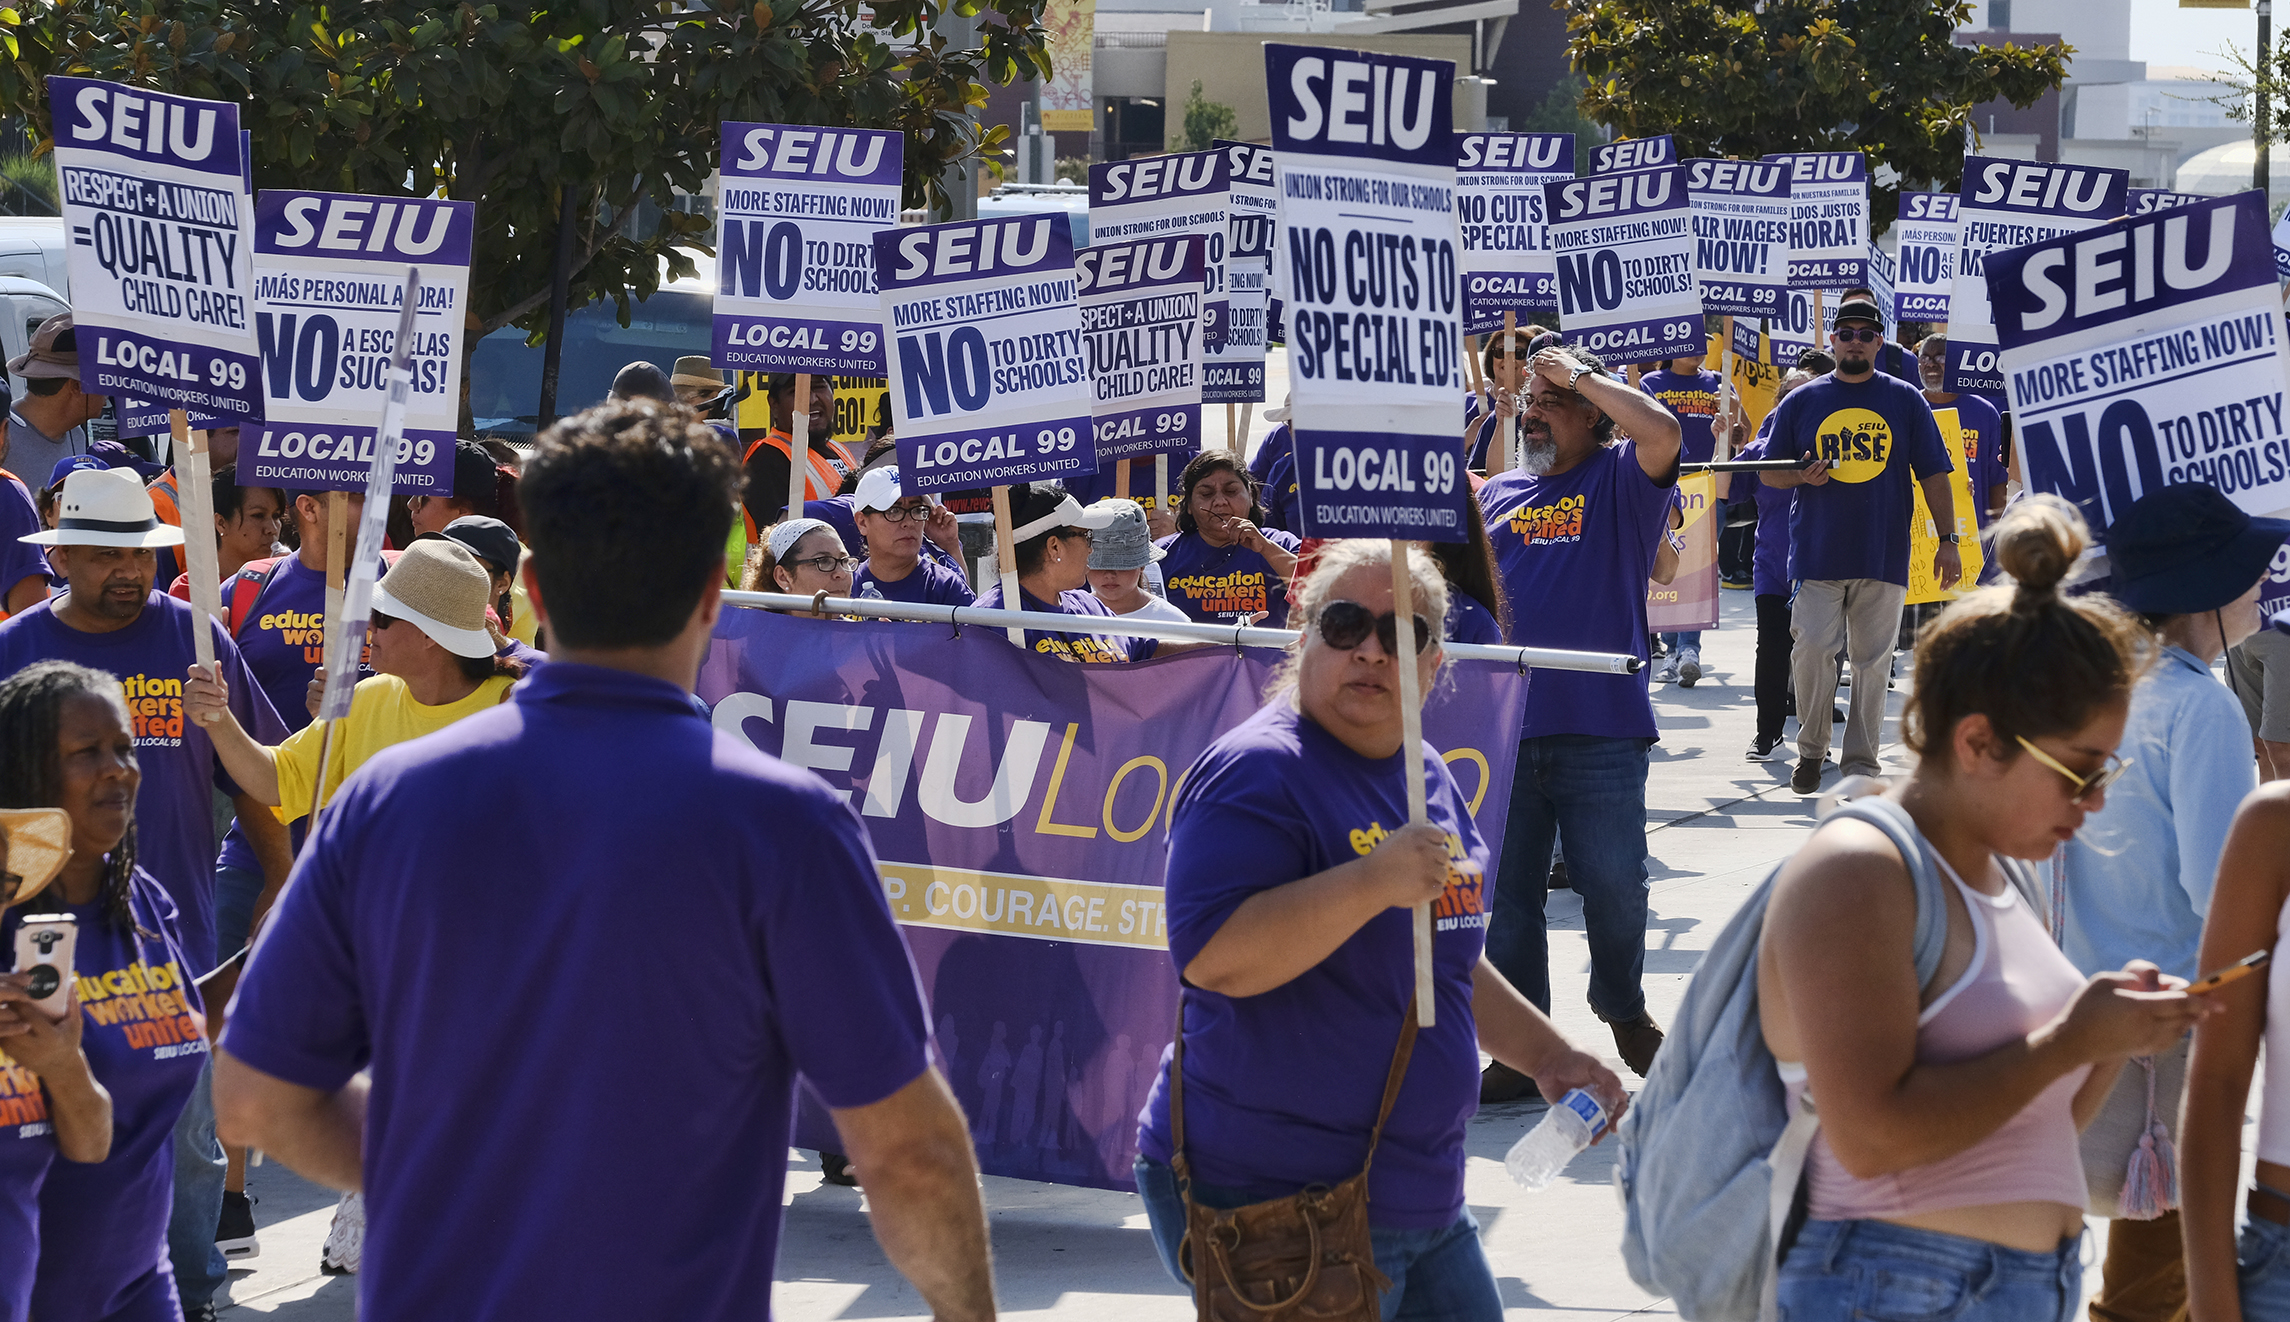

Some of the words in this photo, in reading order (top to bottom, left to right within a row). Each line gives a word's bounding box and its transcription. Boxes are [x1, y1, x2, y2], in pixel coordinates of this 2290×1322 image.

[1287, 56, 1437, 151] SEIU
[71, 86, 216, 161] SEIU
[737, 128, 886, 177] SEIU
[1458, 136, 1563, 169] SEIU
[1596, 138, 1666, 172] SEIU
[1102, 154, 1218, 201] SEIU
[1456, 175, 1479, 186] UNION
[1481, 175, 1509, 186] STRONG
[1510, 175, 1523, 186] FOR
[1525, 175, 1539, 186] OUR
[1687, 161, 1781, 193] SEIU
[1974, 162, 2113, 212] SEIU
[173, 182, 236, 227] UNION
[725, 189, 770, 212] MORE
[774, 191, 847, 217] STAFFING
[851, 198, 895, 219] NOW!
[1235, 194, 1263, 208] STRONG
[1265, 197, 1276, 210] FOR
[1285, 172, 1322, 200] UNION
[1325, 175, 1370, 204] STRONG
[1372, 179, 1390, 206] FOR
[1391, 182, 1410, 208] OUR
[1411, 184, 1452, 213] SCHOOLS
[1559, 171, 1672, 218] SEIU
[1801, 190, 1831, 200] NUESTRAS
[1831, 188, 1860, 198] FAMILIAS
[1095, 226, 1122, 238] UNION
[1123, 220, 1154, 236] STRONG
[1156, 218, 1170, 231] FOR
[1172, 216, 1188, 228] OUR
[1189, 210, 1225, 226] SCHOOLS
[1458, 196, 1486, 224] NO
[1491, 195, 1543, 224] CUTS
[1703, 202, 1728, 212] STRONG
[1728, 203, 1740, 213] FOR
[1742, 204, 1754, 214] OUR
[1755, 206, 1788, 216] FAMILIES
[1820, 202, 1861, 219] JUSTOS
[275, 197, 454, 256] SEIU
[1462, 225, 1538, 251] SPECIAL
[1554, 230, 1588, 249] MORE
[1591, 222, 1649, 244] STAFFING
[1651, 216, 1687, 234] NOW!
[1723, 218, 1787, 244] WAGES
[1901, 229, 1922, 241] ¡MÁS
[1963, 221, 2034, 247] ¡FUERTES
[721, 219, 803, 301] NO
[806, 240, 829, 265] TO
[895, 219, 1051, 281] SEIU
[1075, 239, 1190, 291] SEIU
[1697, 238, 1769, 276] NOW!
[1900, 245, 1940, 285] NO
[1245, 273, 1264, 288] NOW!
[1289, 226, 1336, 305] NO
[1345, 229, 1418, 311] CUTS
[1422, 237, 1456, 315] TO
[1556, 249, 1624, 315] NO
[1623, 260, 1642, 279] TO
[1645, 252, 1690, 276] DIRTY
[1808, 278, 1836, 286] WORKERS
[1837, 277, 1860, 286] UNITED
[1838, 262, 1859, 276] 99
[2021, 205, 2237, 332] SEIU
[304, 280, 388, 305] PERSONAL
[391, 284, 454, 309] AORA!
[1625, 273, 1693, 299] SCHOOLS!
[1752, 288, 1777, 304] 99
[122, 277, 183, 320] CHILD
[186, 287, 245, 330] CARE!
[893, 298, 943, 326] MORE
[946, 286, 1025, 319] STAFFING
[1028, 279, 1077, 305] NOW!
[1148, 294, 1196, 322] UNION
[1239, 307, 1262, 327] DIRTY
[1500, 298, 1534, 306] WORKERS
[1721, 303, 1750, 314] WORKERS
[1751, 304, 1776, 315] UNITED
[1901, 311, 1933, 320] EDUCATION
[727, 323, 830, 350] LOCAL
[840, 329, 878, 353] 99
[1295, 308, 1416, 385] SPECIAL
[1419, 319, 1459, 388] ED!
[1577, 326, 1655, 351] LOCAL
[1663, 321, 1692, 340] 99
[1749, 335, 1758, 349] 99
[97, 338, 199, 382] LOCAL
[209, 358, 246, 390] 99
[257, 312, 339, 402] NO
[343, 328, 355, 350] A
[726, 352, 785, 364] EDUCATION
[788, 355, 836, 368] WORKERS
[839, 358, 877, 371] UNITED
[1625, 347, 1663, 361] WORKERS
[1665, 343, 1695, 355] UNITED
[2014, 358, 2088, 408] MORE
[2091, 333, 2199, 389] STAFFING
[2201, 312, 2275, 362] NOW!
[897, 326, 991, 420] NO
[990, 338, 1015, 366] TO
[1020, 328, 1081, 360] DIRTY
[995, 357, 1086, 395] SCHOOLS!
[1097, 371, 1143, 401] CHILD
[1147, 363, 1194, 393] CARE!
[1202, 368, 1243, 386] LOCAL
[1248, 367, 1262, 384] 99
[99, 373, 157, 400] EDUCATION
[158, 385, 209, 408] WORKERS
[210, 395, 250, 413] UNITED
[1655, 389, 1716, 400] education
[835, 397, 866, 435] GO!
[1155, 411, 1187, 434] 99
[1857, 422, 1886, 431] SEIU
[257, 431, 375, 463] LOCAL
[394, 438, 435, 466] 99
[916, 432, 1025, 468] LOCAL
[1037, 426, 1076, 453] 99
[1114, 440, 1153, 455] WORKERS
[1155, 437, 1187, 449] UNITED
[1820, 426, 1887, 463] RISE
[917, 469, 982, 487] EDUCATION
[985, 462, 1036, 480] WORKERS
[1039, 456, 1080, 474] UNITED
[1314, 447, 1416, 493] LOCAL
[1423, 450, 1456, 495] 99
[2021, 398, 2168, 529] NO
[2158, 415, 2196, 463] TO
[2199, 391, 2283, 454] DIRTY
[255, 465, 326, 481] EDUCATION
[391, 474, 435, 487] UNITED
[1317, 505, 1379, 526] EDUCATION
[1380, 507, 1424, 527] WORKERS
[1425, 508, 1457, 528] UNITED
[1530, 536, 1548, 546] SEIU
[1571, 534, 1580, 543] 99
[1168, 571, 1265, 589] education
[1185, 584, 1266, 600] workers
[1201, 595, 1267, 613] united
[1217, 610, 1235, 619] SEIU
[141, 738, 169, 747] LOCAL
[170, 738, 182, 748] 99
[925, 880, 1109, 933] COURAGE.
